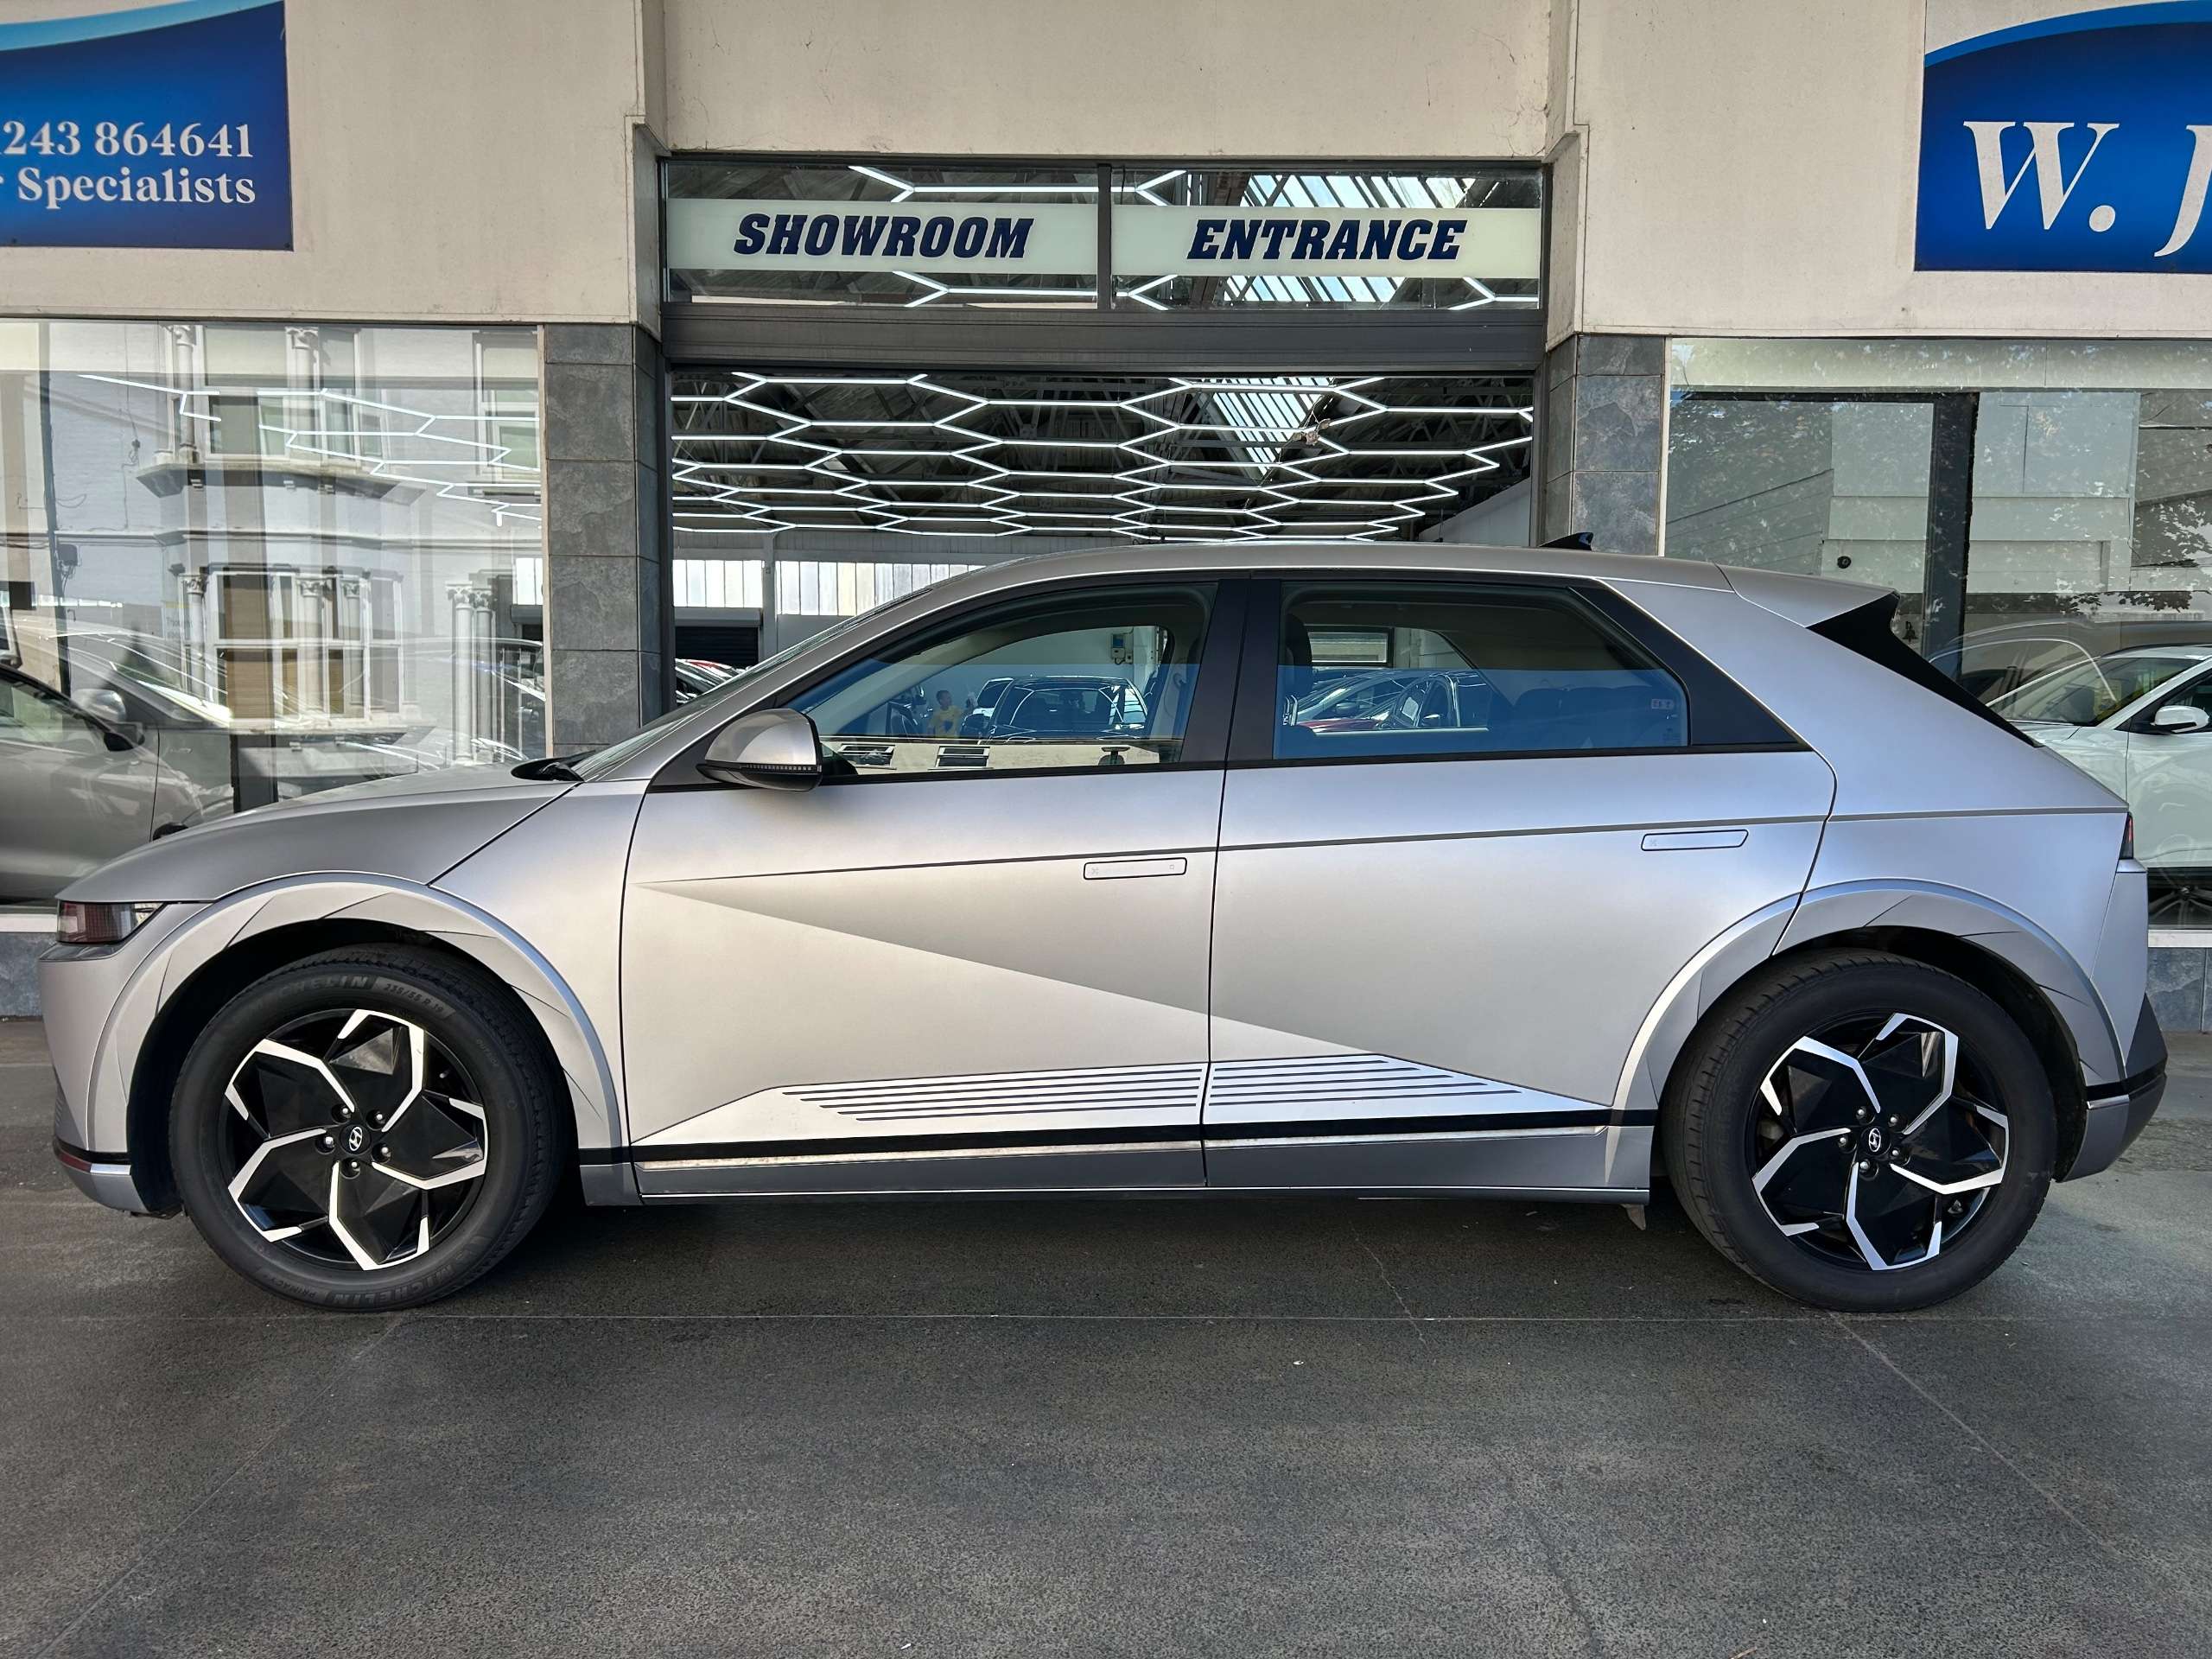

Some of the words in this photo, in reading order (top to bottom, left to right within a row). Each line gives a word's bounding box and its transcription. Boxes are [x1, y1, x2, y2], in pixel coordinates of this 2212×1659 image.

[0, 120, 81, 156] 243
[94, 122, 254, 158] 864641
[17, 166, 256, 210] Specialists
[1962, 121, 2120, 232] W.
[734, 213, 1034, 258] SHOWROOM
[1187, 219, 1468, 261] ENTRANCE
